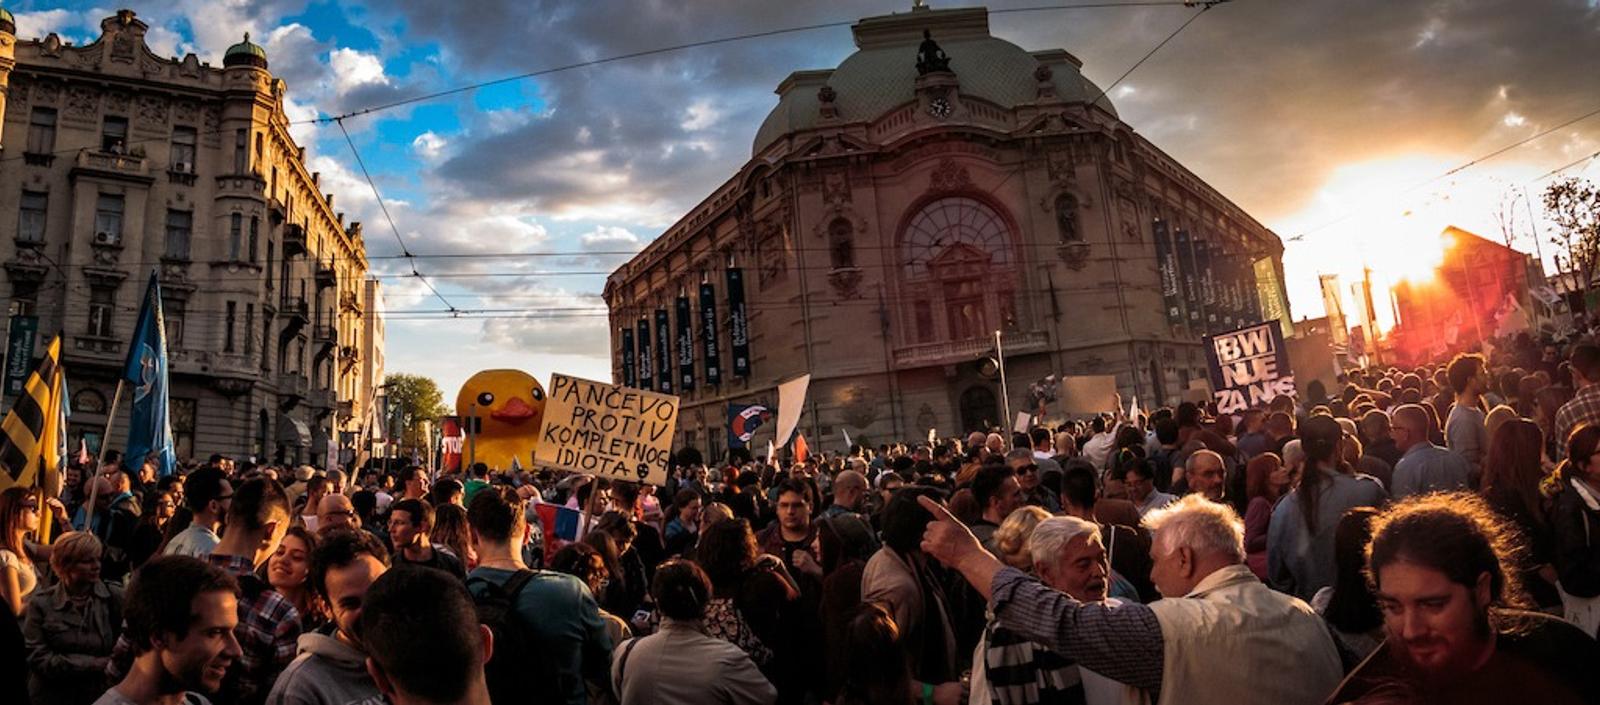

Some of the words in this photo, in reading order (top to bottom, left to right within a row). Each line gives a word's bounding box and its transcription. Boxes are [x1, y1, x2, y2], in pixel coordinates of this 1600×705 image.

[1218, 329, 1268, 361] BW
[552, 376, 674, 422] PANČEVO
[1214, 389, 1248, 414] ZA
[571, 406, 668, 442] PROTIV
[440, 436, 462, 454] STOP
[544, 422, 669, 471] KOMPLETNOG
